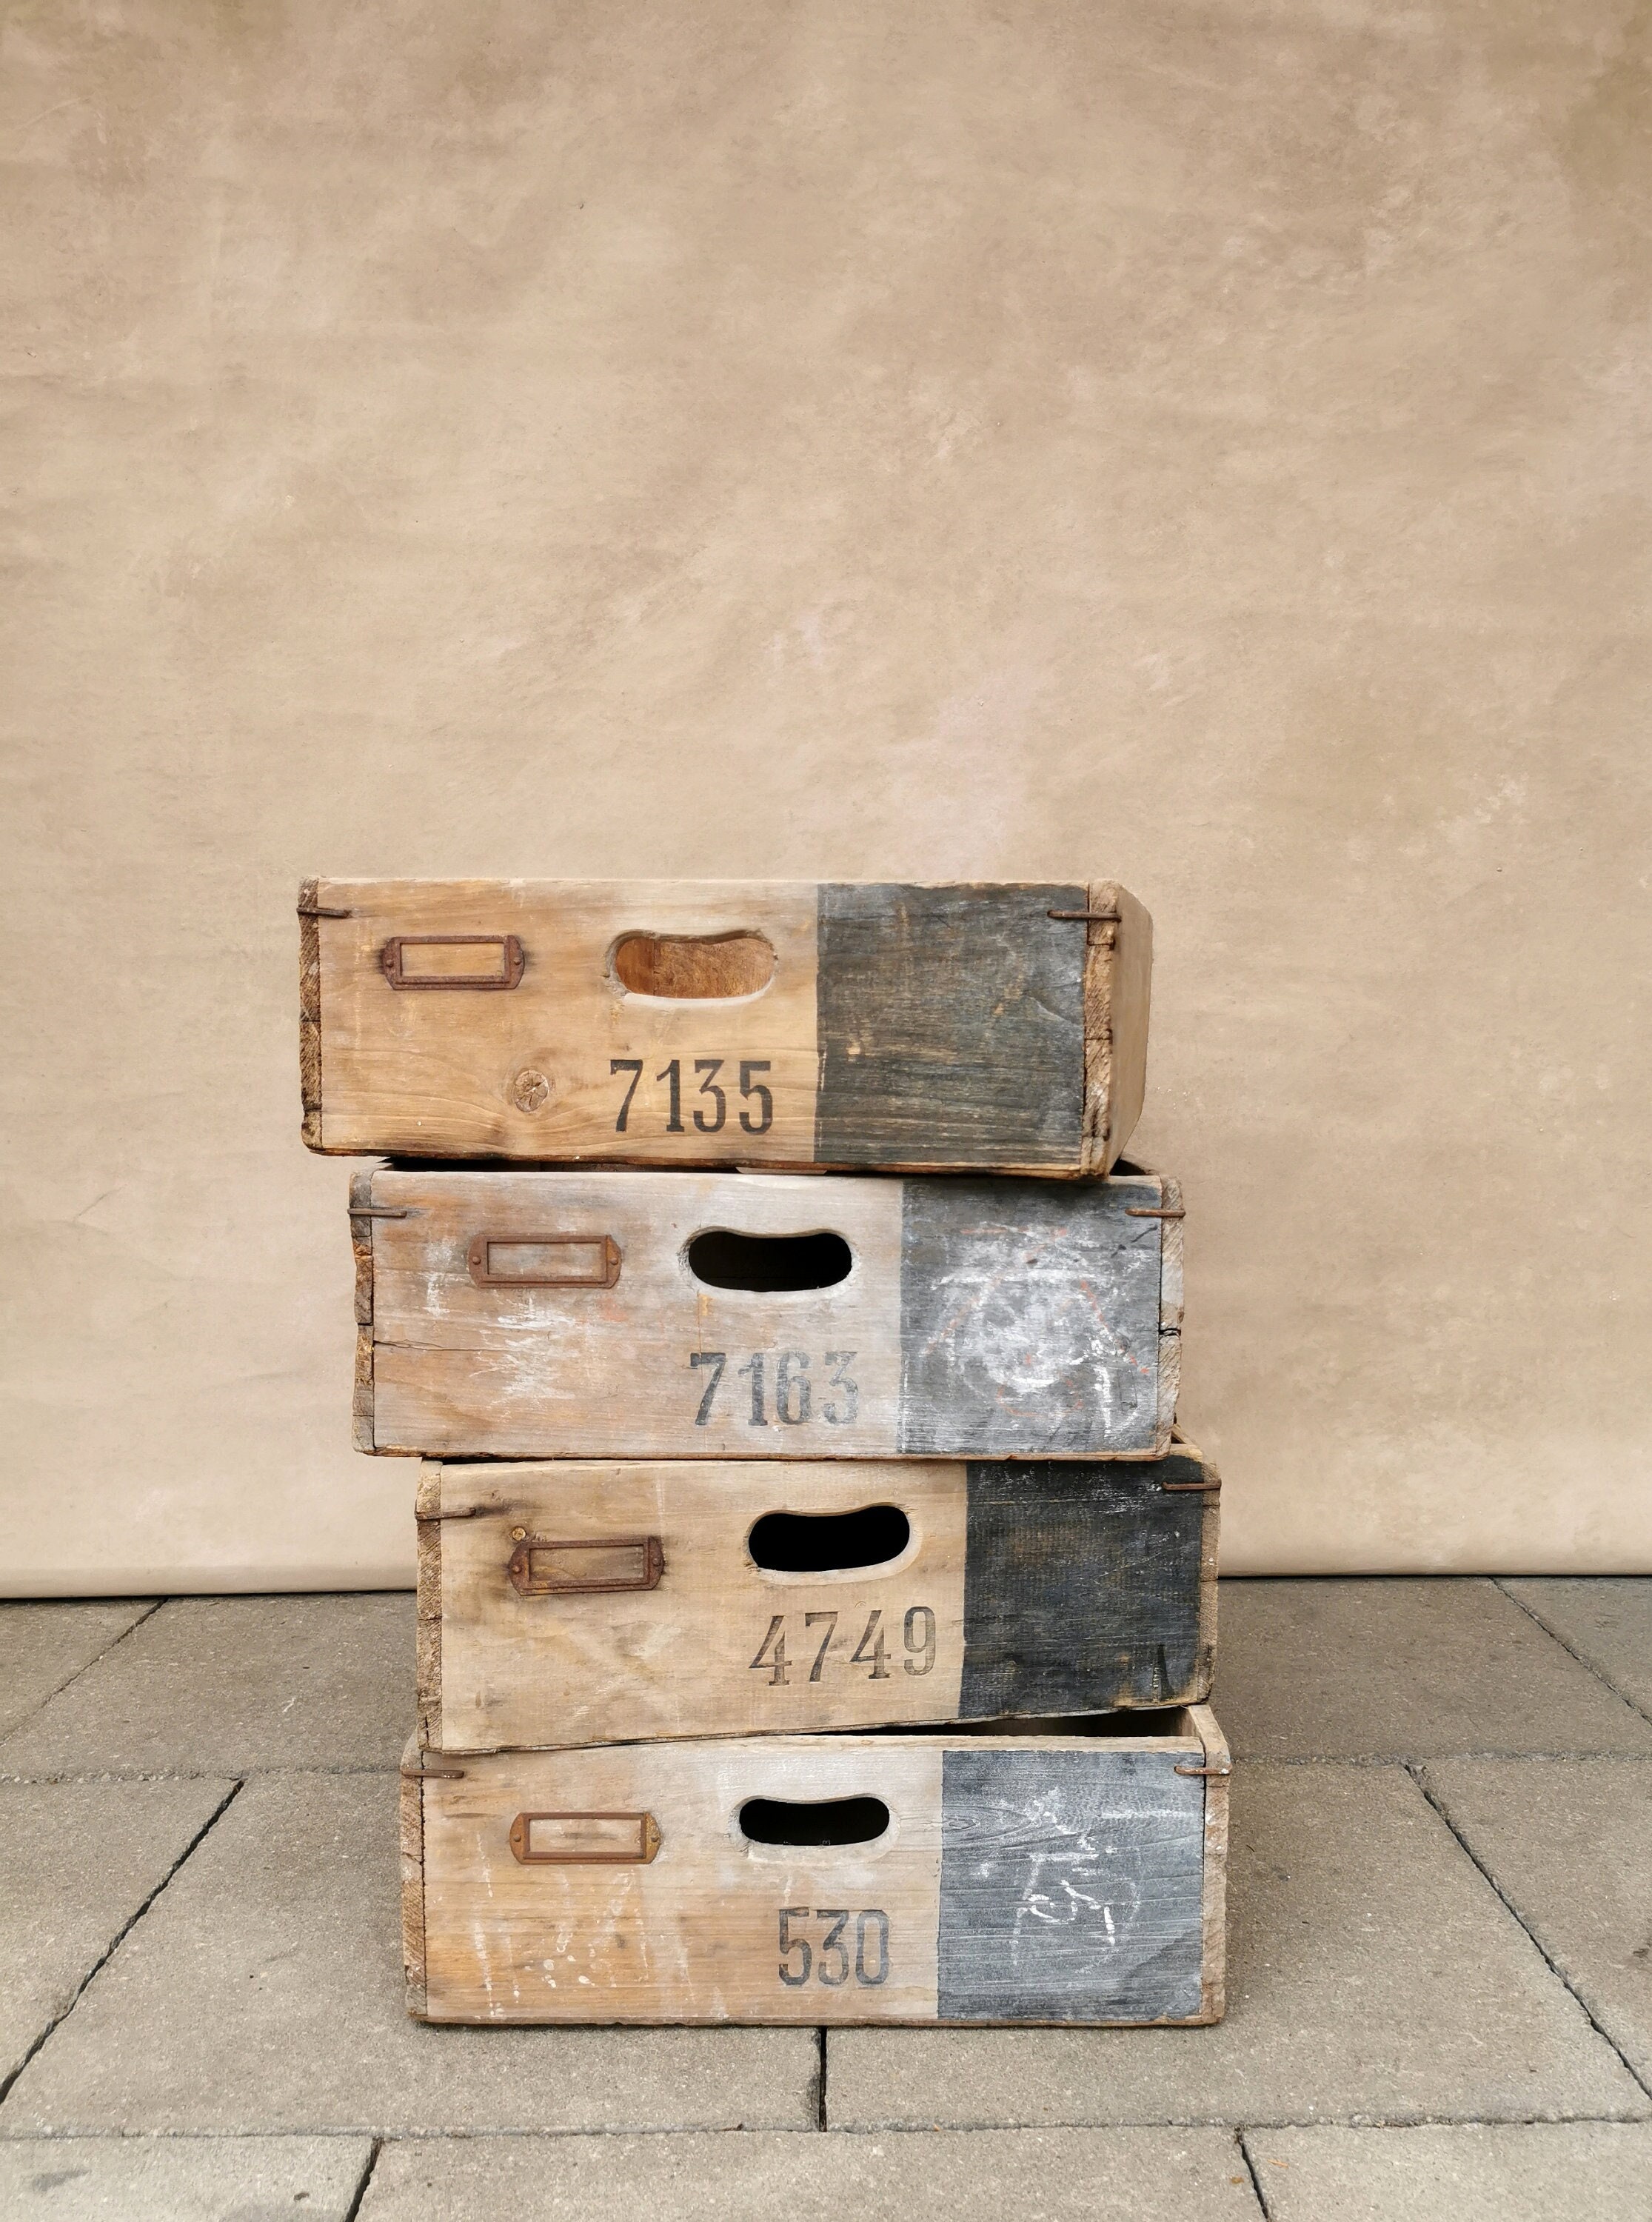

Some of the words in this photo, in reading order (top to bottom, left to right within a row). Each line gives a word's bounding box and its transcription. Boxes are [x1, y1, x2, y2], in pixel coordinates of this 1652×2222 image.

[610, 1059, 772, 1135] 7135
[689, 1350, 859, 1427] 7163
[749, 1606, 937, 1686] 4749
[777, 1906, 889, 1986] 530
